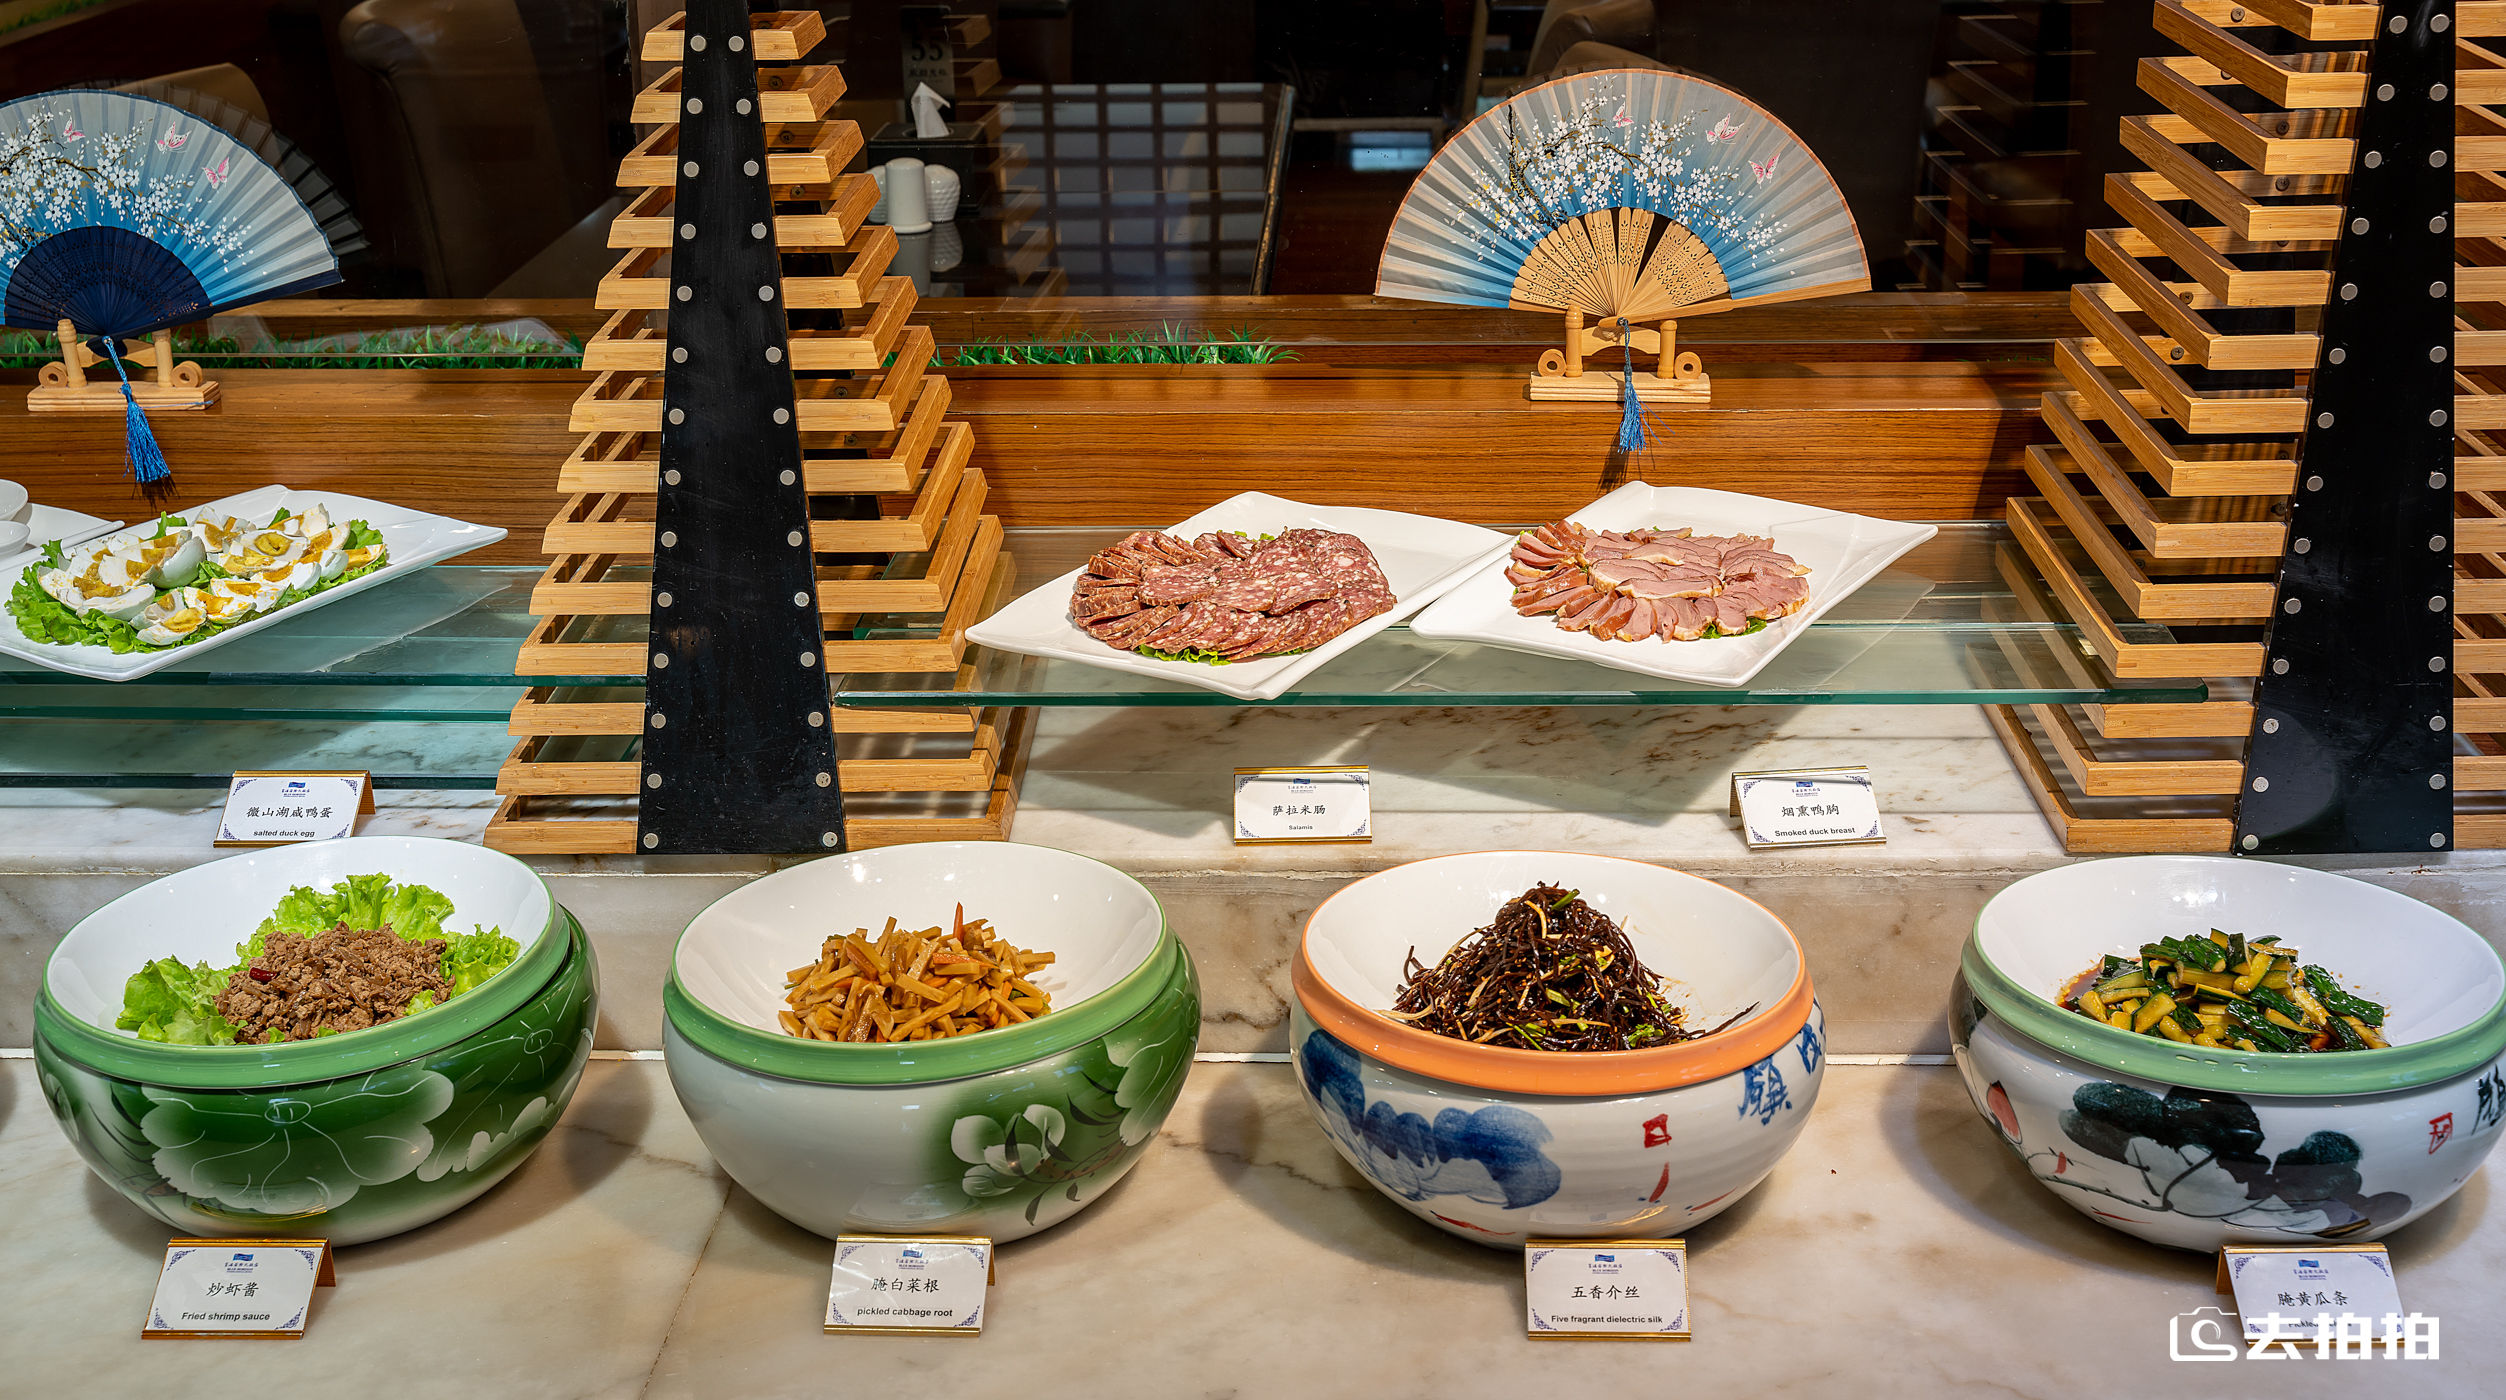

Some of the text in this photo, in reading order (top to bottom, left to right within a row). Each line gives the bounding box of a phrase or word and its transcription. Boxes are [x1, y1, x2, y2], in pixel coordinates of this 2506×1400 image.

[1272, 804, 1326, 816] 萨拉米肠
[1781, 803, 1840, 818] 烟熏鸭胸
[253, 829, 315, 838] salted duck egg
[1774, 829, 1807, 837] Smoked
[1809, 828, 1829, 836] duck
[206, 1281, 260, 1298] 炒虾酱
[870, 1276, 940, 1294] 腌白菜根
[1570, 1284, 1640, 1300] 五香介丝
[2277, 1290, 2349, 1307] 腌黄瓜条
[181, 1312, 270, 1322] Fried shrimp sauce
[857, 1307, 953, 1318] pickled cabbage root
[1551, 1315, 1663, 1324] Five fragrant dielectric silk
